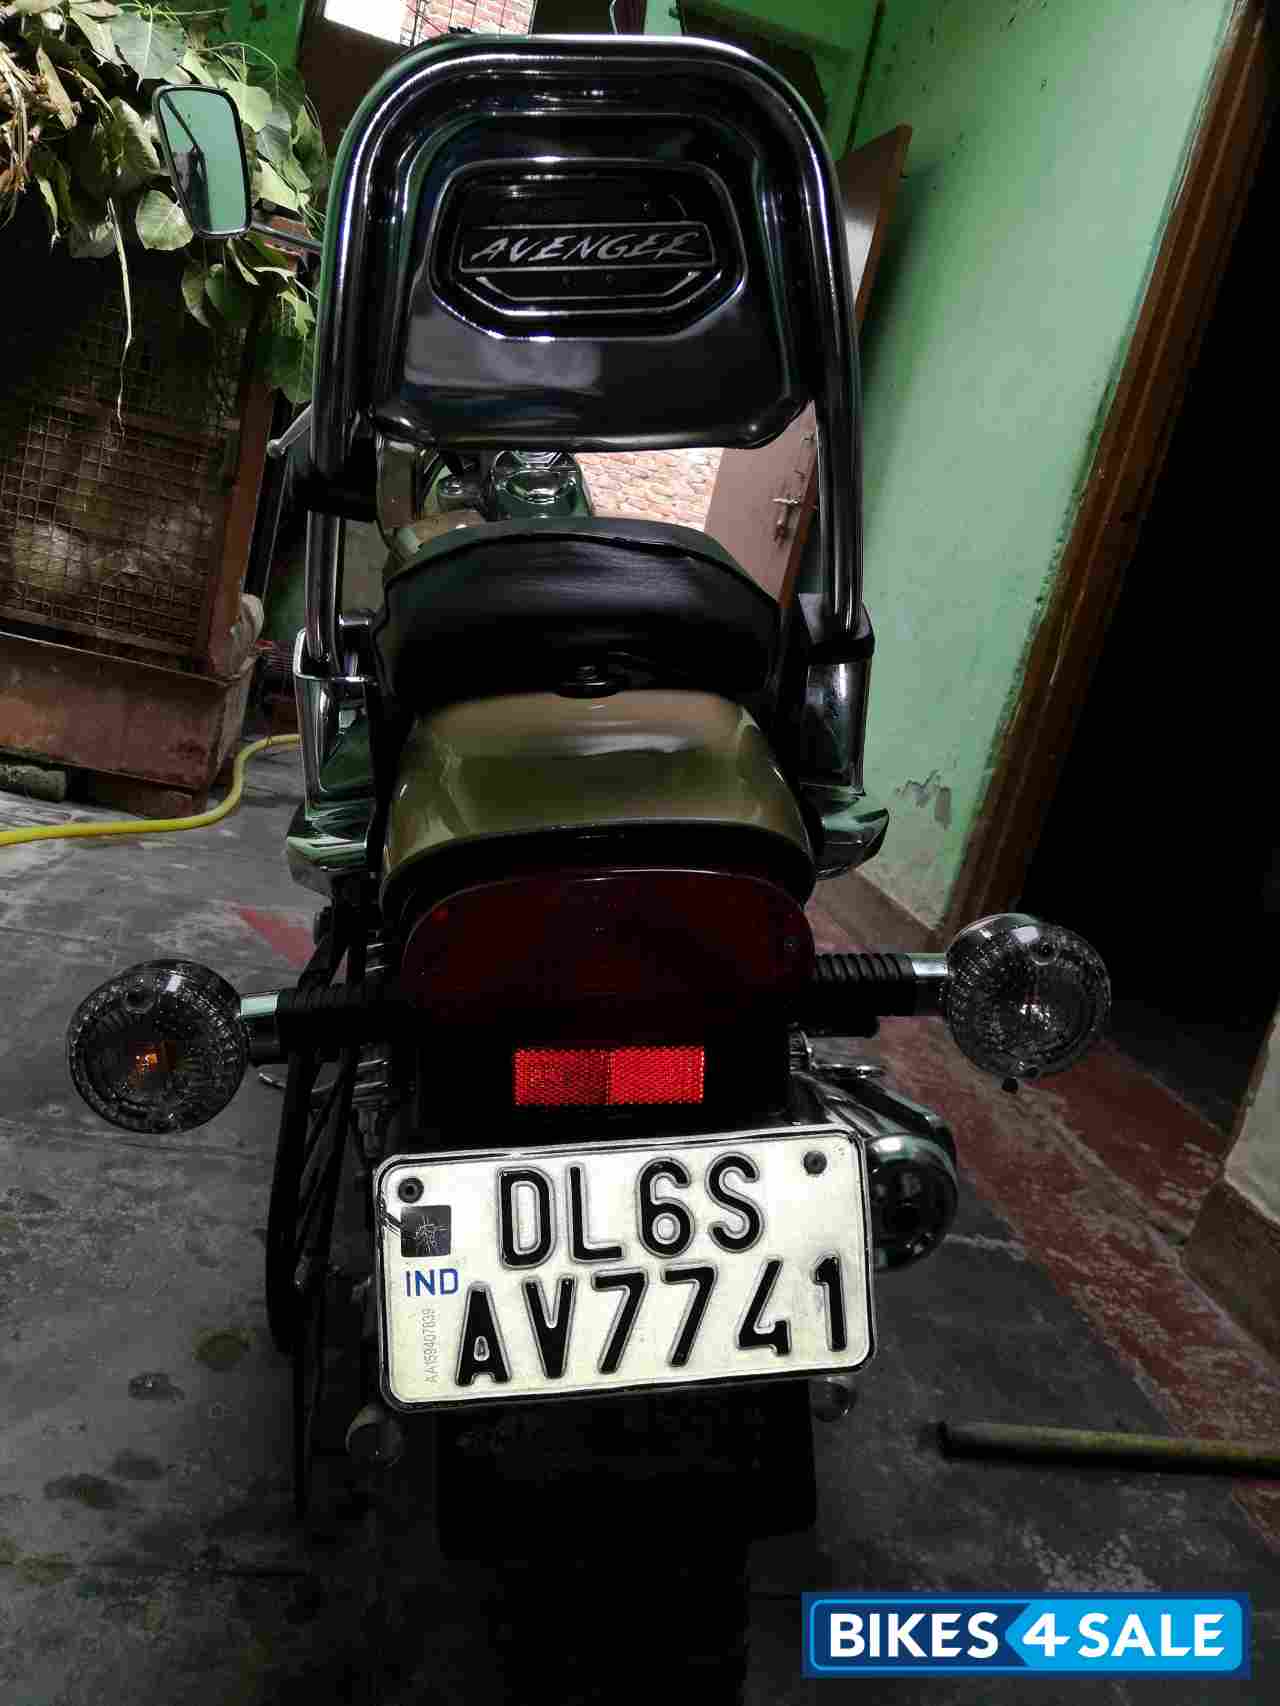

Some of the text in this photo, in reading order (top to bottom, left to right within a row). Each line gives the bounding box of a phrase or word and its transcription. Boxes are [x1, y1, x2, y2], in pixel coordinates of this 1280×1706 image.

[470, 232, 700, 263] AVENGER
[498, 1152, 766, 1270] DL6S
[405, 1268, 459, 1297] IND
[455, 1255, 850, 1387] AV7741
